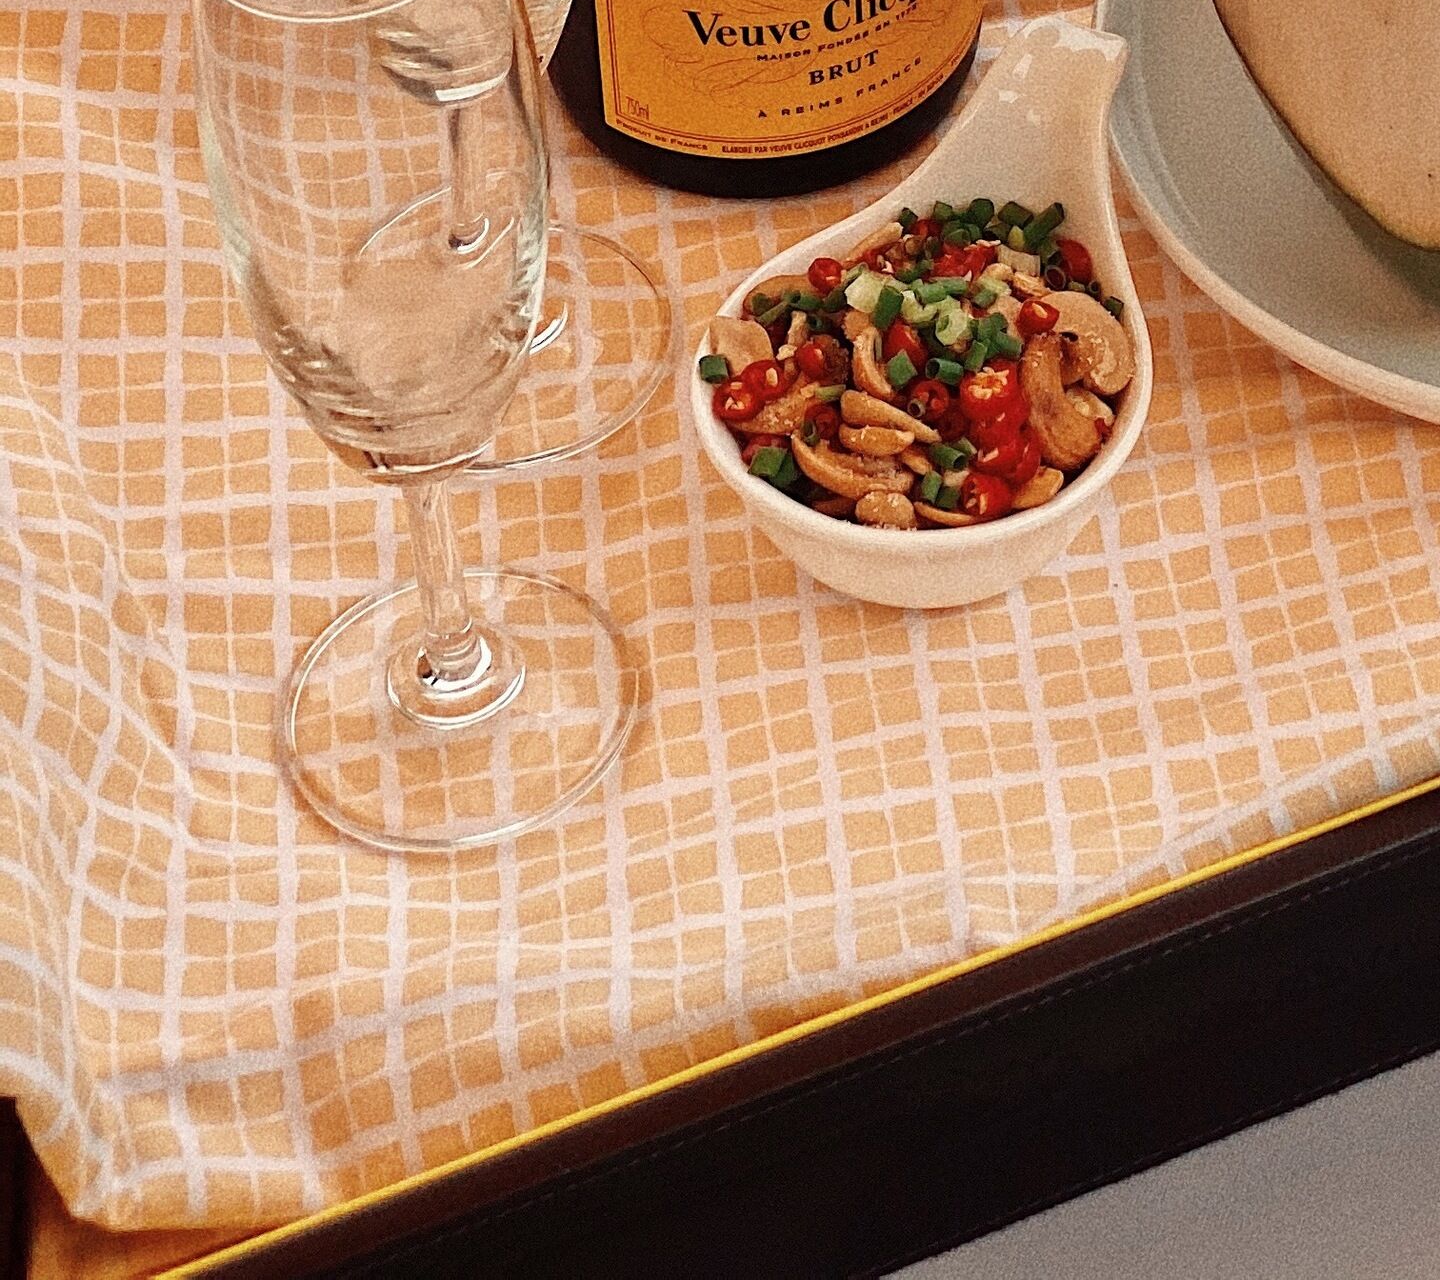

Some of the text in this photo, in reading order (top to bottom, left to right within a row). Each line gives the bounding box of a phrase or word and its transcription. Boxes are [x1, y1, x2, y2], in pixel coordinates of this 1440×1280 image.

[682, 9, 811, 48] Veuve
[756, 48, 812, 62] MAISON
[808, 49, 879, 86] BRUT
[781, 96, 843, 116] REIMS
[855, 56, 921, 97] FRANCE
[625, 95, 650, 121] 750ml
